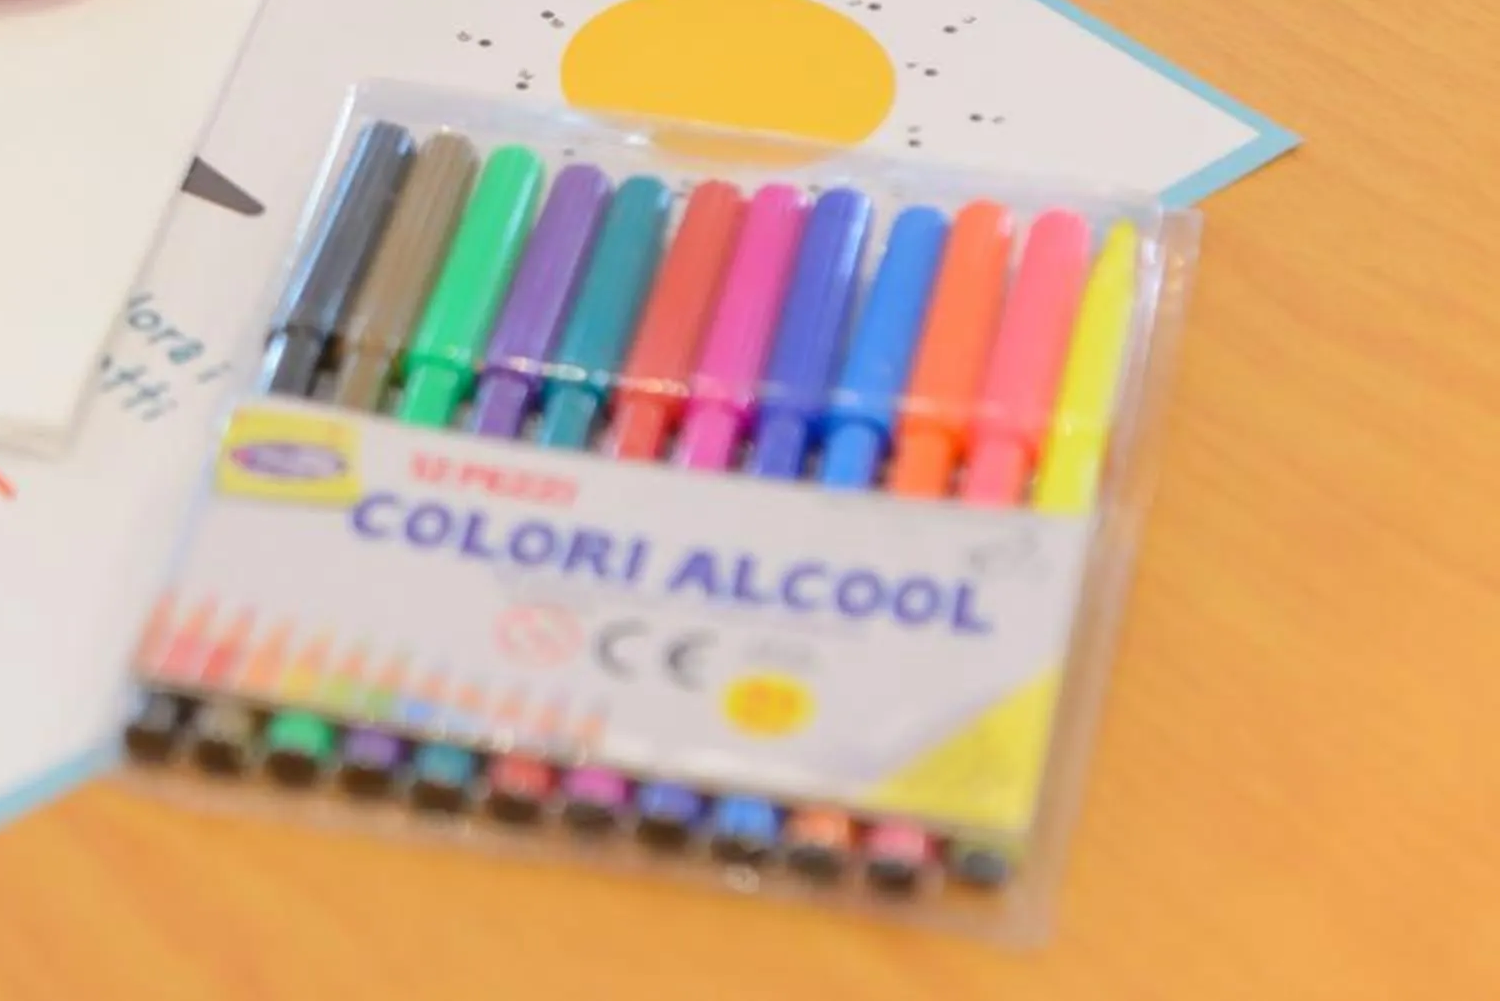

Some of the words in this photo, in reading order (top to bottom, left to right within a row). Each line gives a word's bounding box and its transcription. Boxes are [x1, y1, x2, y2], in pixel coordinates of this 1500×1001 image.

[126, 291, 206, 365] lora
[101, 352, 179, 422] tti
[348, 491, 651, 585] COLORI
[664, 544, 995, 637] ALCOOL
